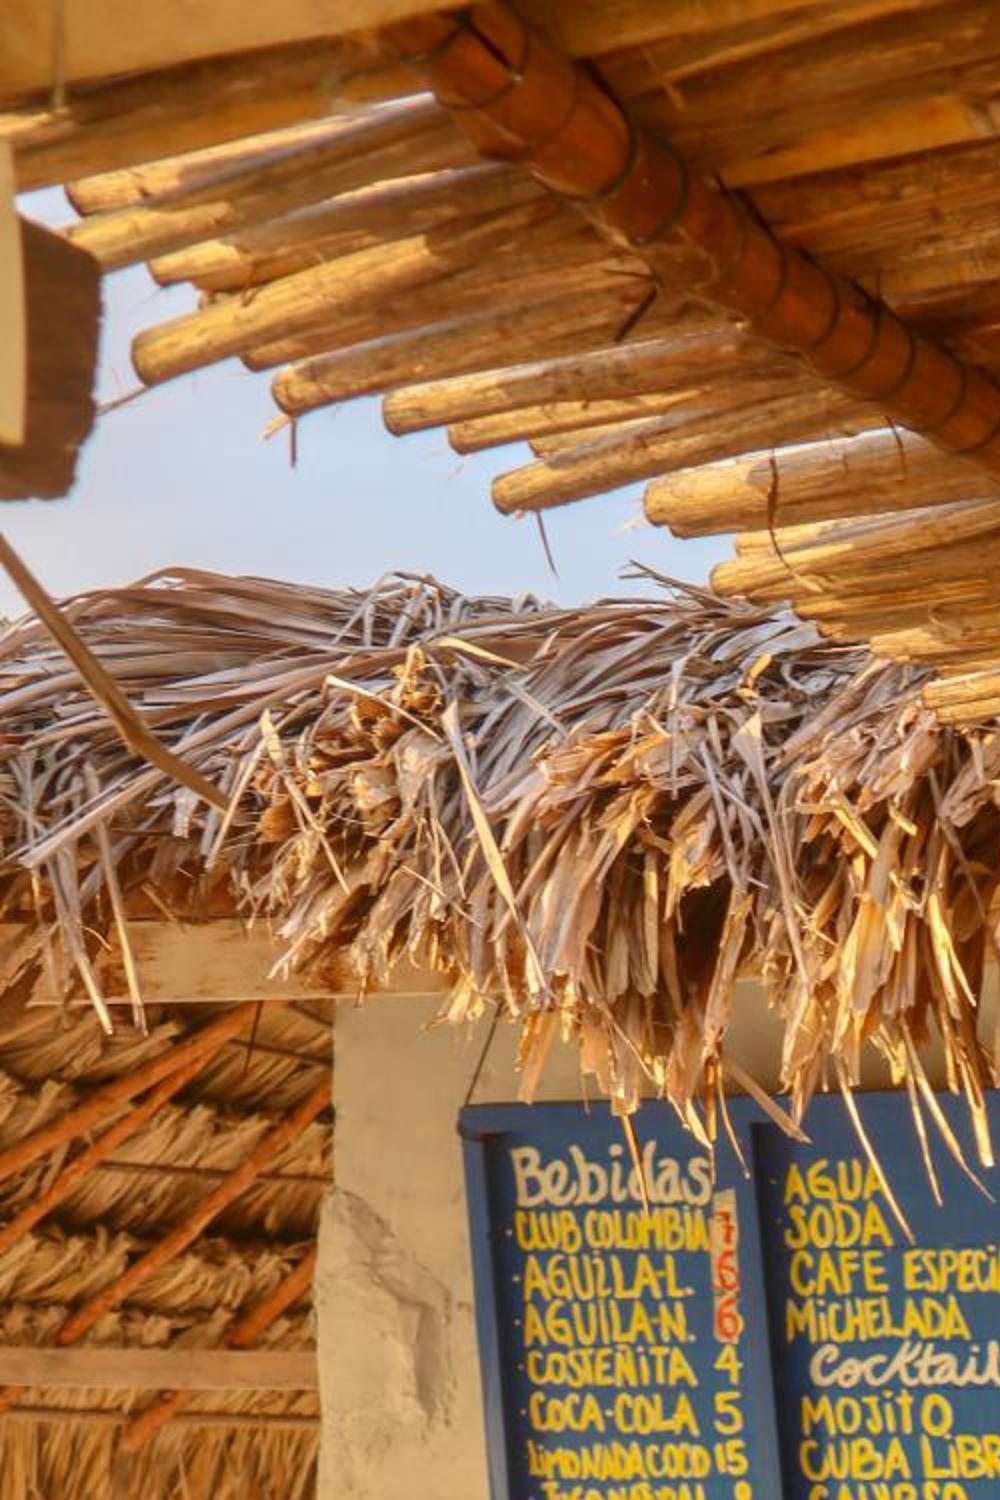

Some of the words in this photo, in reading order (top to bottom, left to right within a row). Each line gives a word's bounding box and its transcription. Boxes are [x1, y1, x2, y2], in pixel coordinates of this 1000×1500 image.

[511, 1140, 714, 1208] Bebidas
[783, 1158, 888, 1206] AGUA
[515, 1210, 583, 1254] CLUB
[715, 1210, 736, 1243] 7
[784, 1200, 894, 1249] SODA
[714, 1250, 738, 1292] 6
[790, 1248, 889, 1297] CAFE
[713, 1294, 741, 1339] 6
[714, 1345, 744, 1386] 4
[713, 1391, 744, 1435] 5
[714, 1439, 750, 1477] 15
[801, 1437, 913, 1482] CUBA
